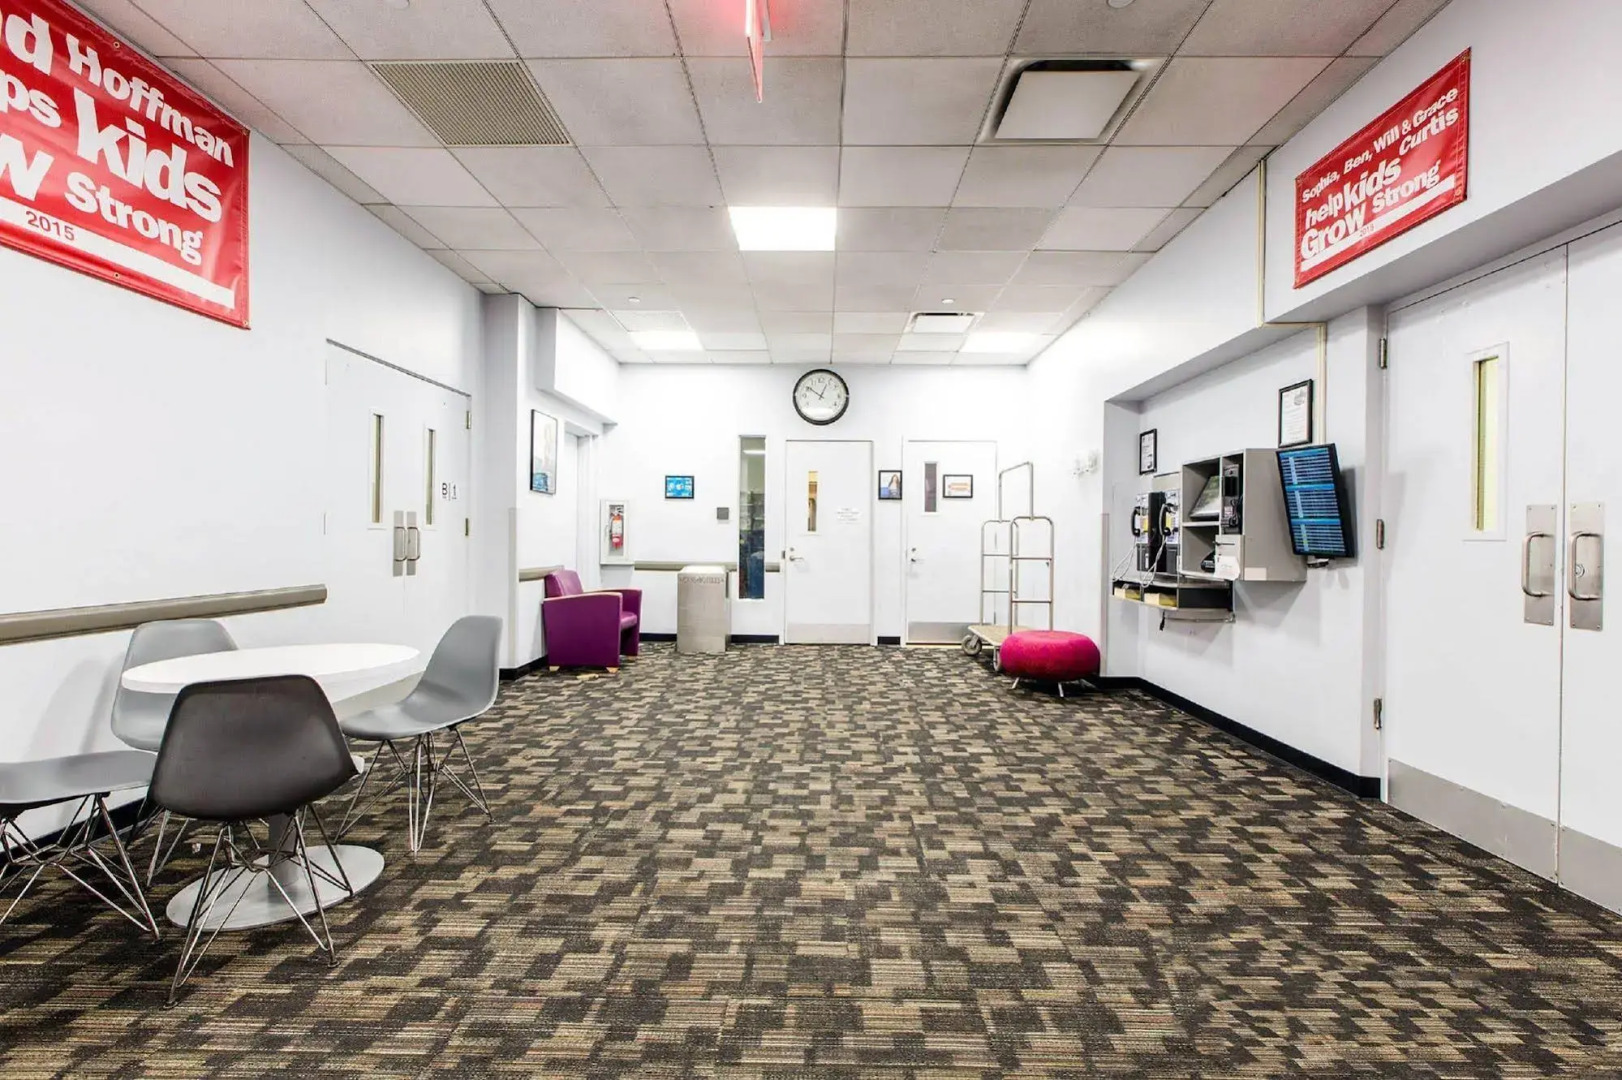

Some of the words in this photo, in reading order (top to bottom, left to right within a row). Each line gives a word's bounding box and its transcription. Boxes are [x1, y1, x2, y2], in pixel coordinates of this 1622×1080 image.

[0, 11, 53, 75] d
[66, 32, 234, 168] Hoffman
[1399, 107, 1459, 155] Curtis
[74, 86, 222, 223] kids
[1302, 171, 1340, 203] Sophia,
[1344, 151, 1373, 174] Ben,
[1373, 125, 1400, 153] Will
[1401, 120, 1412, 135] &
[1412, 88, 1458, 128] Grace
[25, 211, 75, 241] 2015
[1305, 192, 1343, 231] help
[1343, 158, 1401, 212] kids
